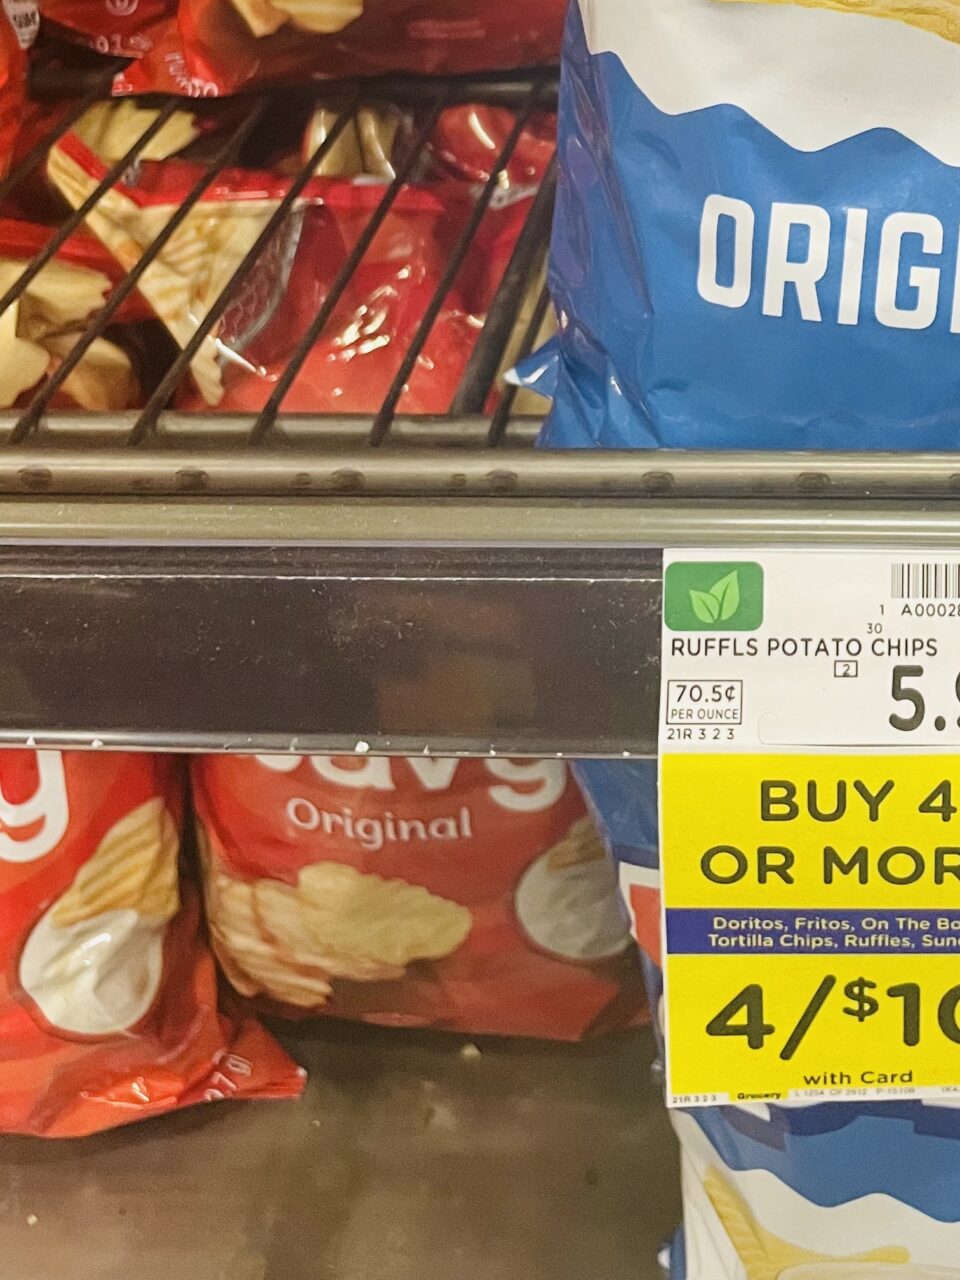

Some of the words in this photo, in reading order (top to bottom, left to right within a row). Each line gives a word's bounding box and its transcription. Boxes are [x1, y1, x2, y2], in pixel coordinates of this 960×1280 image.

[866, 623, 883, 635] 30
[671, 638, 758, 657] RUFFLS
[768, 638, 862, 657] POTATO
[871, 638, 938, 657] CHIPS
[842, 663, 851, 677] 2
[671, 708, 694, 720] PER
[698, 708, 739, 720] OUNCE
[667, 728, 693, 740] 21R
[698, 728, 707, 740] 3
[713, 728, 721, 740] 2
[727, 728, 735, 740] 3
[761, 780, 894, 822] BUY
[918, 780, 957, 822] 4
[286, 797, 472, 851] Original
[700, 846, 794, 885] OR
[713, 917, 788, 931] Doritos,
[796, 917, 854, 931] Fritos,
[862, 918, 888, 930] On
[896, 917, 929, 930] The
[708, 933, 774, 947] Tortilla
[780, 933, 838, 948] Chips,
[845, 933, 915, 948] Ruffles,
[803, 1072, 851, 1085] with
[861, 1070, 913, 1084] Card
[737, 1091, 782, 1101] Grocery
